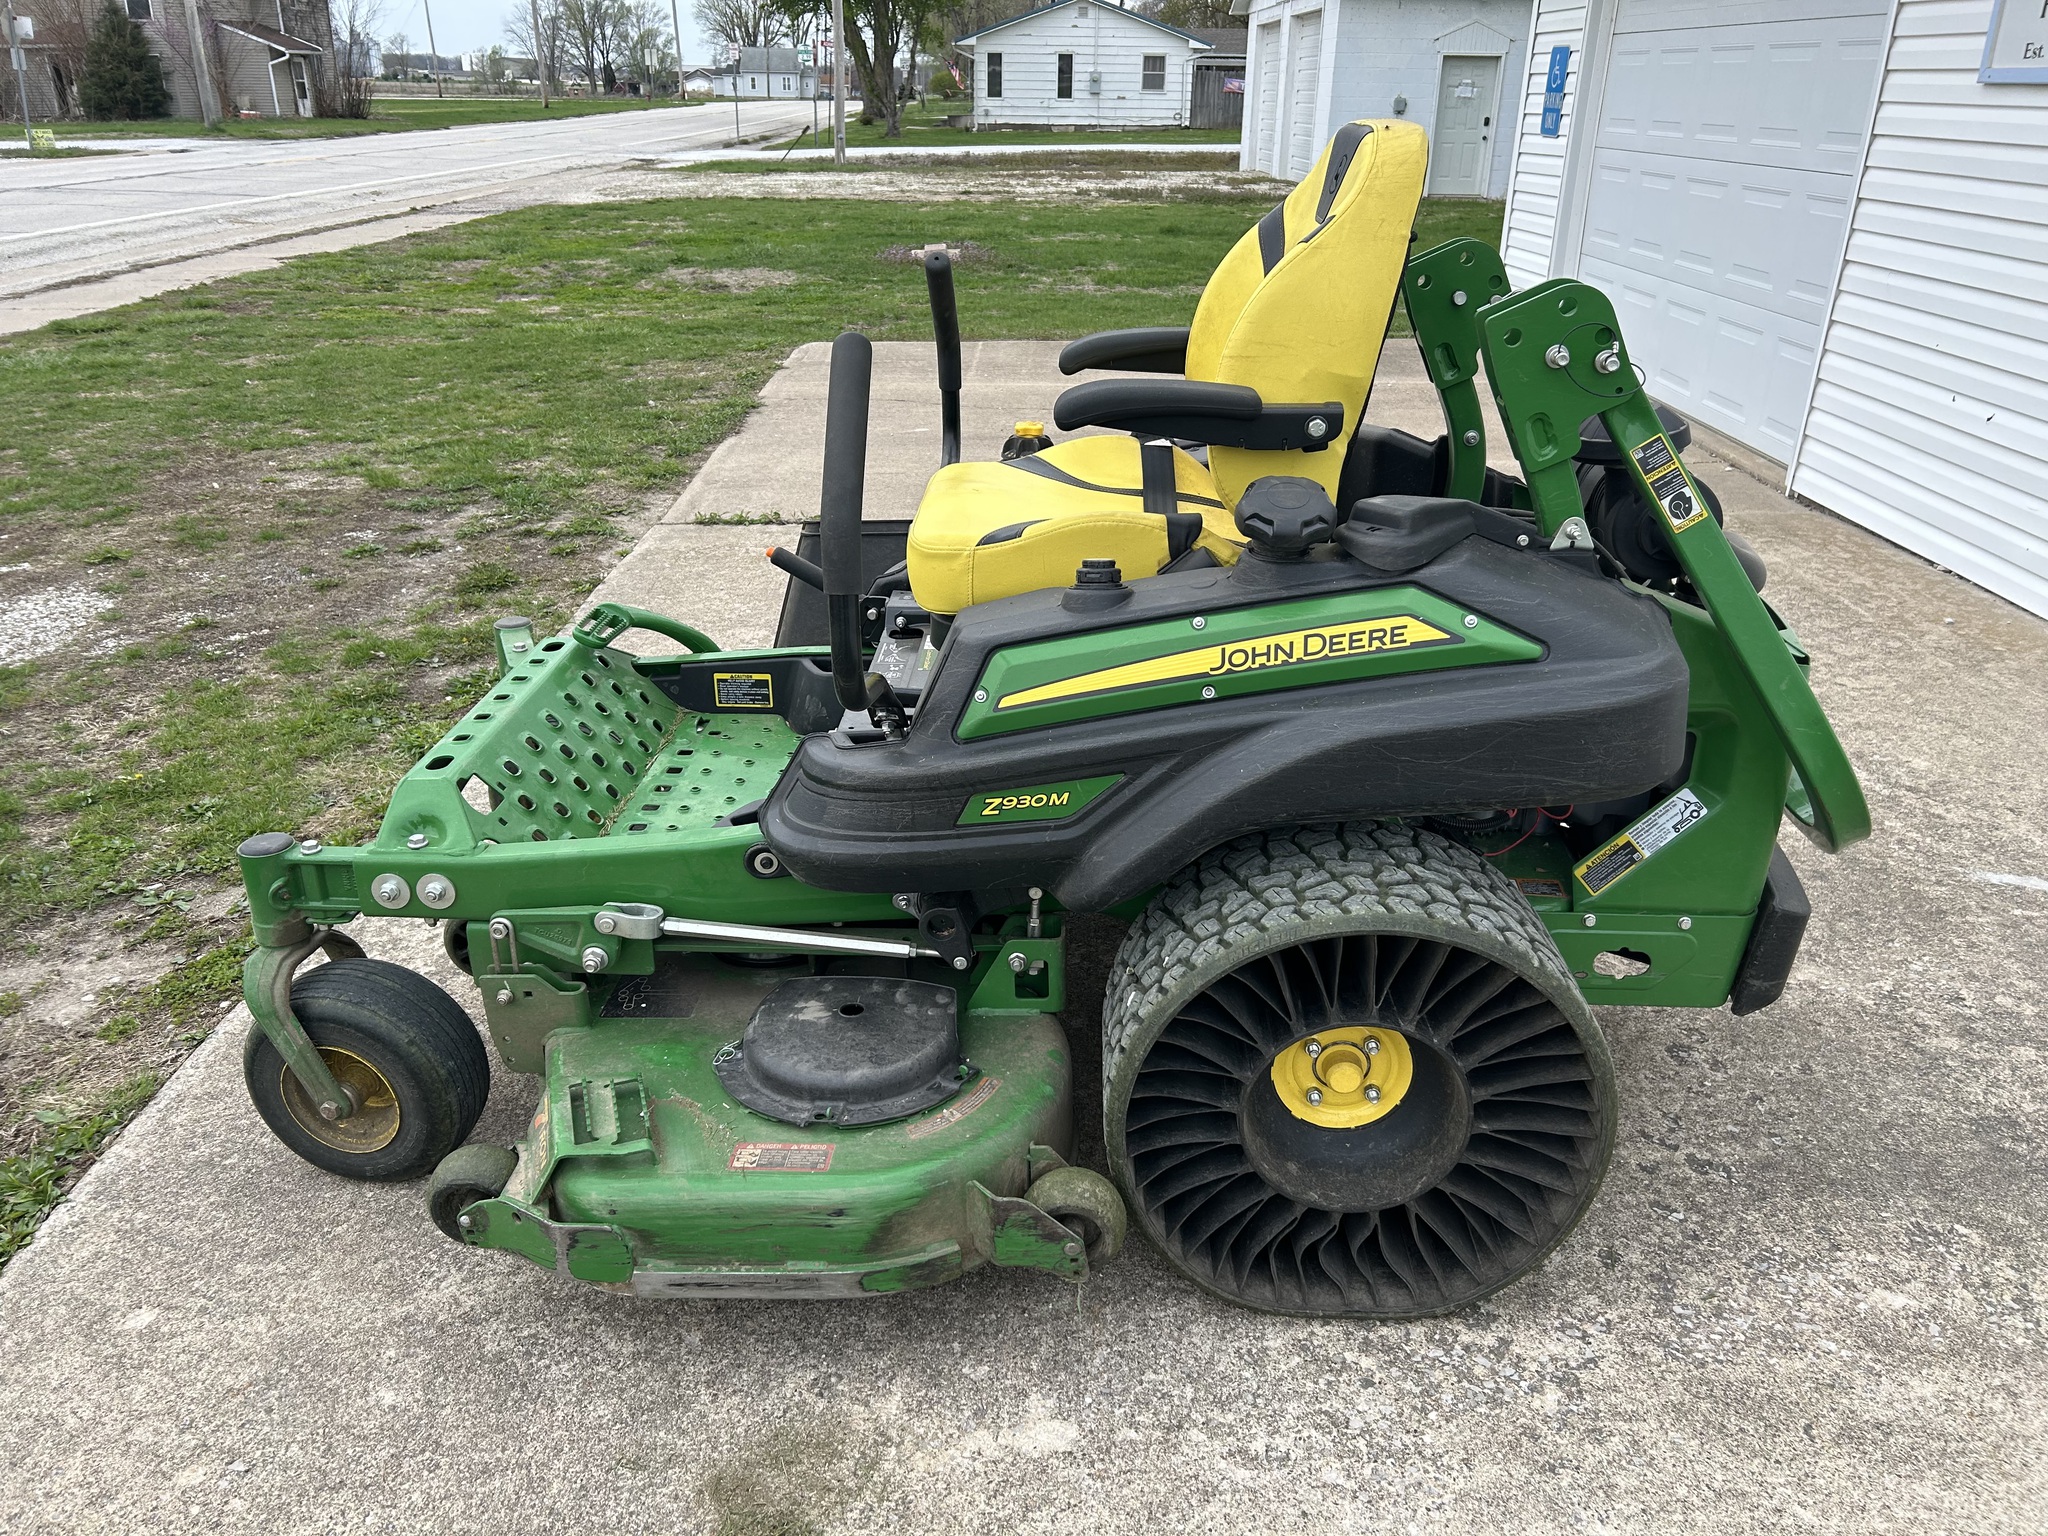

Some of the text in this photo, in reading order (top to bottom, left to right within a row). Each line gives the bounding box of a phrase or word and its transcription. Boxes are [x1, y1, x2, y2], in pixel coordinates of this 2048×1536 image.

[2023, 42, 2044, 59] Est.
[1544, 92, 1563, 109] PARKING
[1544, 112, 1556, 129] ONLY
[1210, 625, 1408, 672] JOHN DEERE
[982, 792, 1070, 816] Z930M
[1591, 842, 1620, 866] ATENCIÓN
